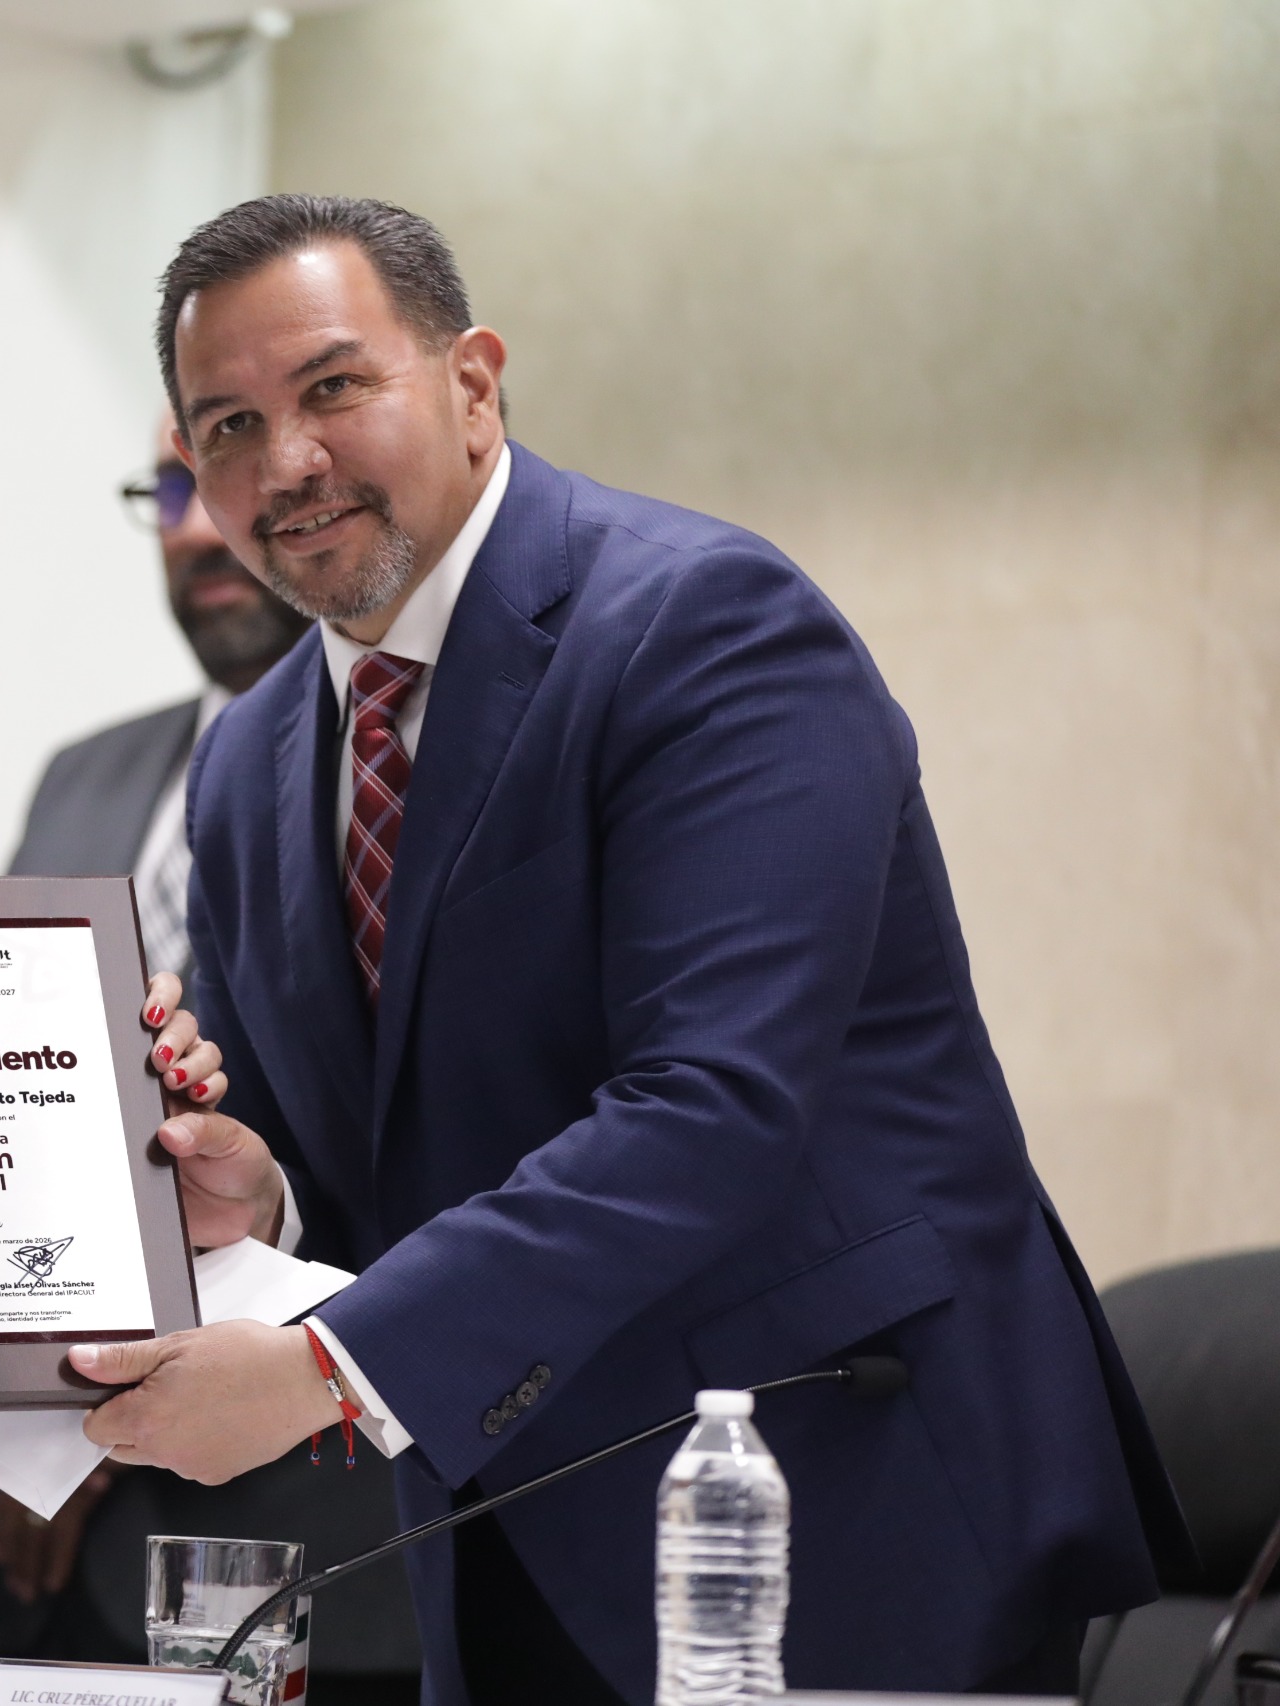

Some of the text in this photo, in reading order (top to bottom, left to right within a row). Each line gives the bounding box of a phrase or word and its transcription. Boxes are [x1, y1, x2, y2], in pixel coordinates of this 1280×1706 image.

[18, 1090, 76, 1106] Tejeda
[62, 1280, 95, 1288] Sánchez
[11, 1690, 34, 1703] LIC.
[37, 1691, 73, 1705] CRUZ
[73, 1690, 115, 1706] PÉREZ
